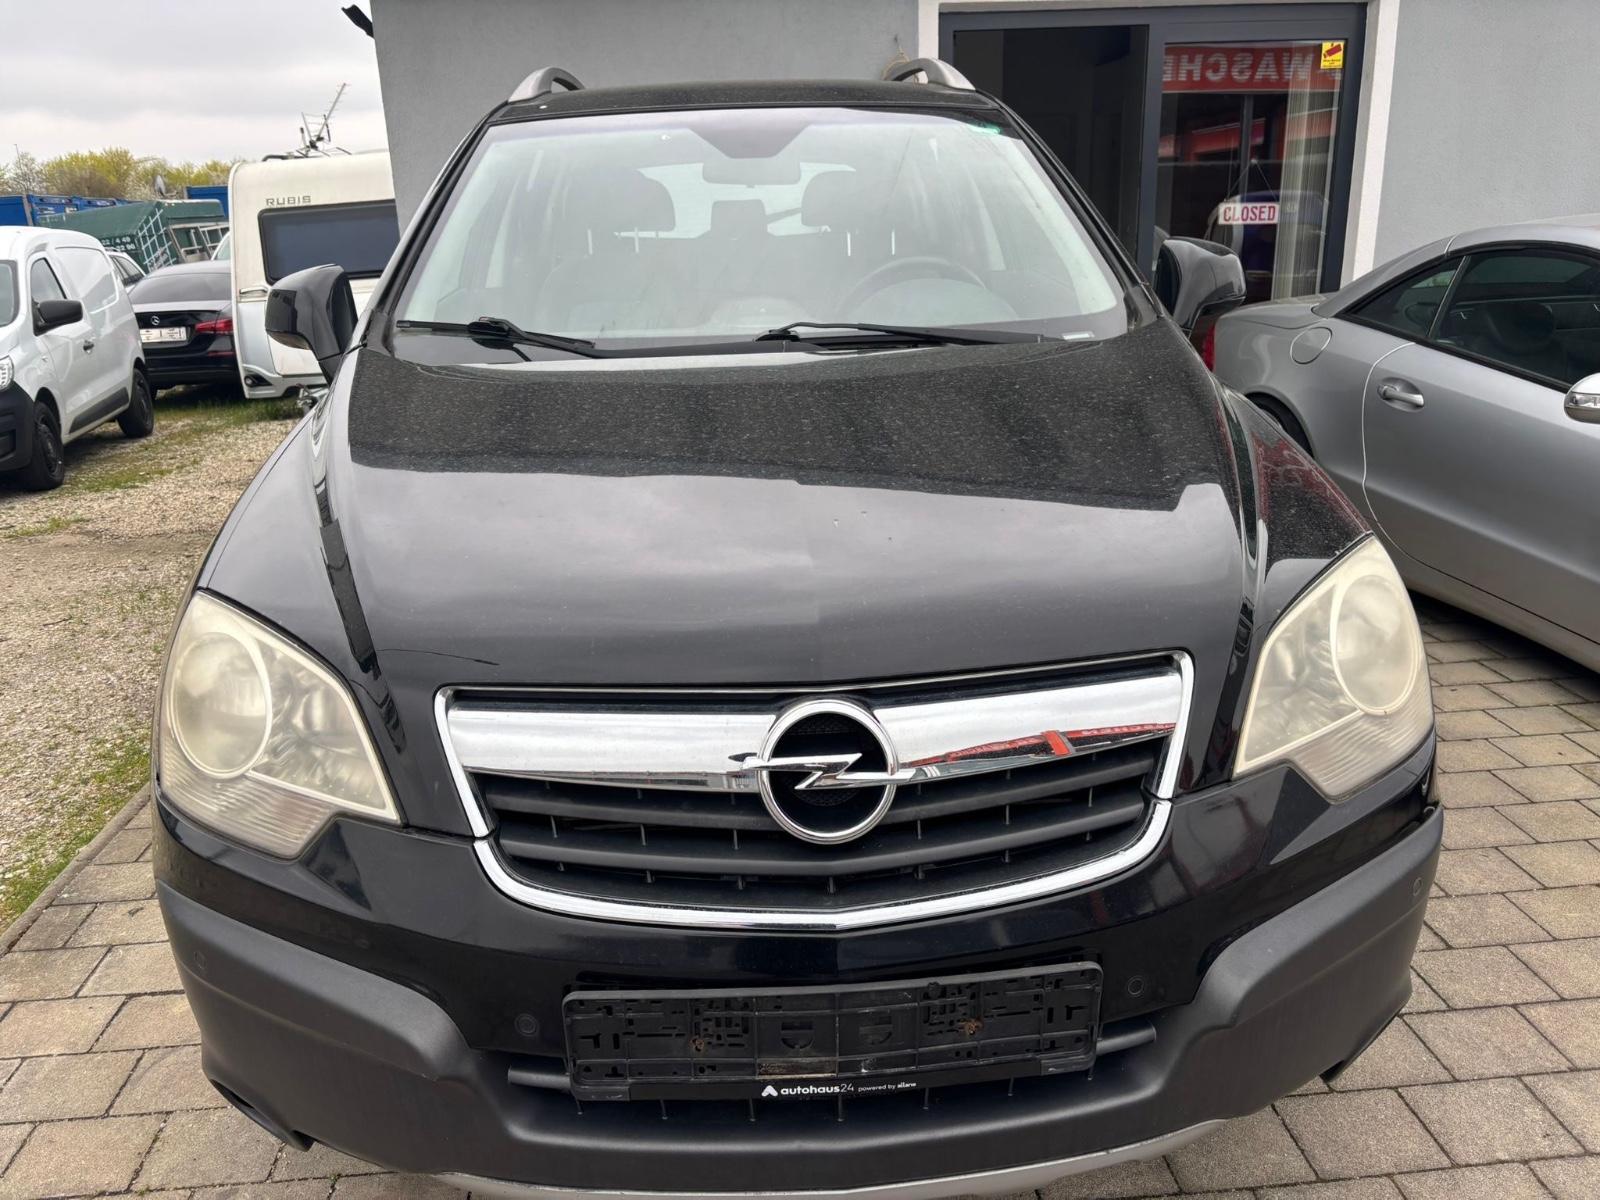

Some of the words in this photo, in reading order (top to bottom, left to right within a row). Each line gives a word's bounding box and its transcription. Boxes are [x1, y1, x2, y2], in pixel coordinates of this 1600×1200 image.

[265, 195, 311, 206] RUBIS
[1224, 205, 1276, 222] CLOSED
[780, 1084, 854, 1095] autohaus24
[858, 1084, 887, 1092] powered
